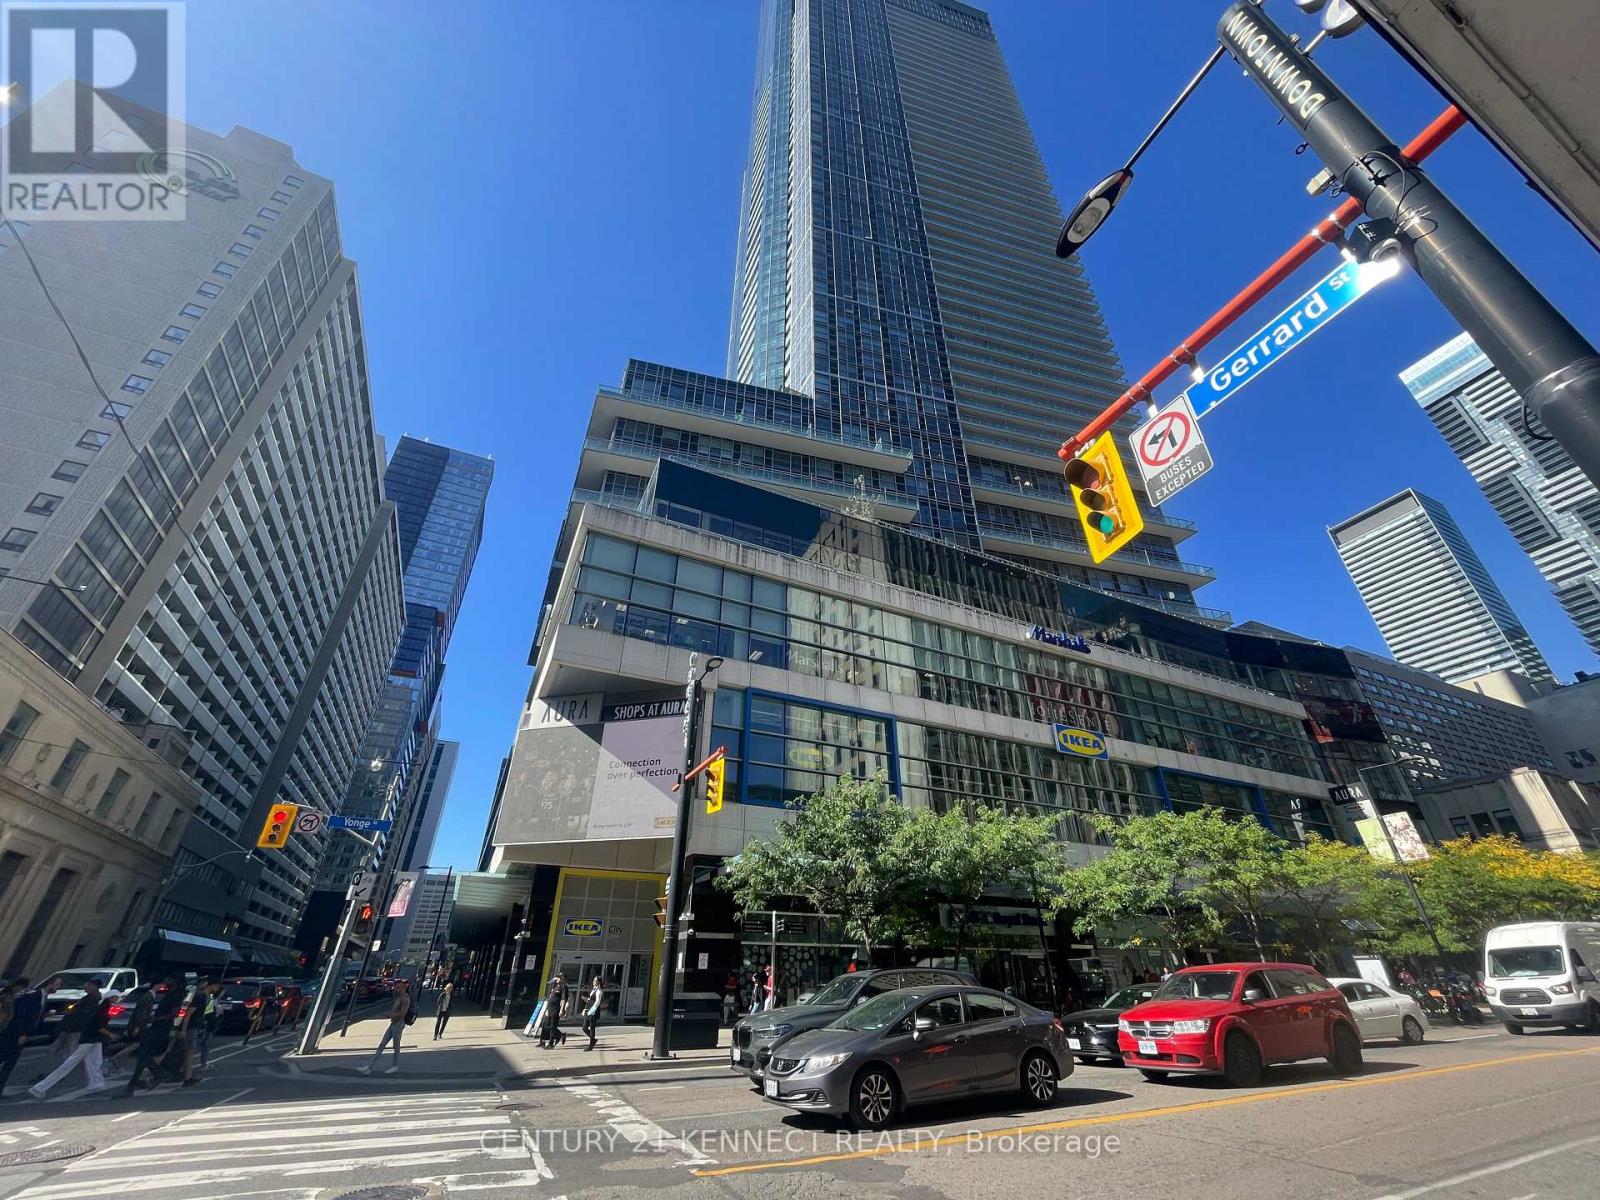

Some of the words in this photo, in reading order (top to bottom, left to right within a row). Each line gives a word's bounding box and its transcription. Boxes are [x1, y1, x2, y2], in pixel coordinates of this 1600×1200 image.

[1226, 11, 1326, 119] DOWNTOWN
[1210, 291, 1329, 391] Gerrard
[1160, 456, 1192, 483] BUSES
[1155, 461, 1205, 500] EXCEPTED
[1026, 624, 1092, 655] Marshalls
[541, 699, 588, 723] AURA
[614, 704, 645, 720] SHOPS
[648, 703, 661, 717] AT
[1062, 733, 1104, 751] IKEA
[609, 758, 661, 769] Connection
[1334, 786, 1364, 801] AURA
[344, 817, 371, 829] Yonge
[569, 923, 599, 931] IKEA
[608, 925, 624, 935] City
